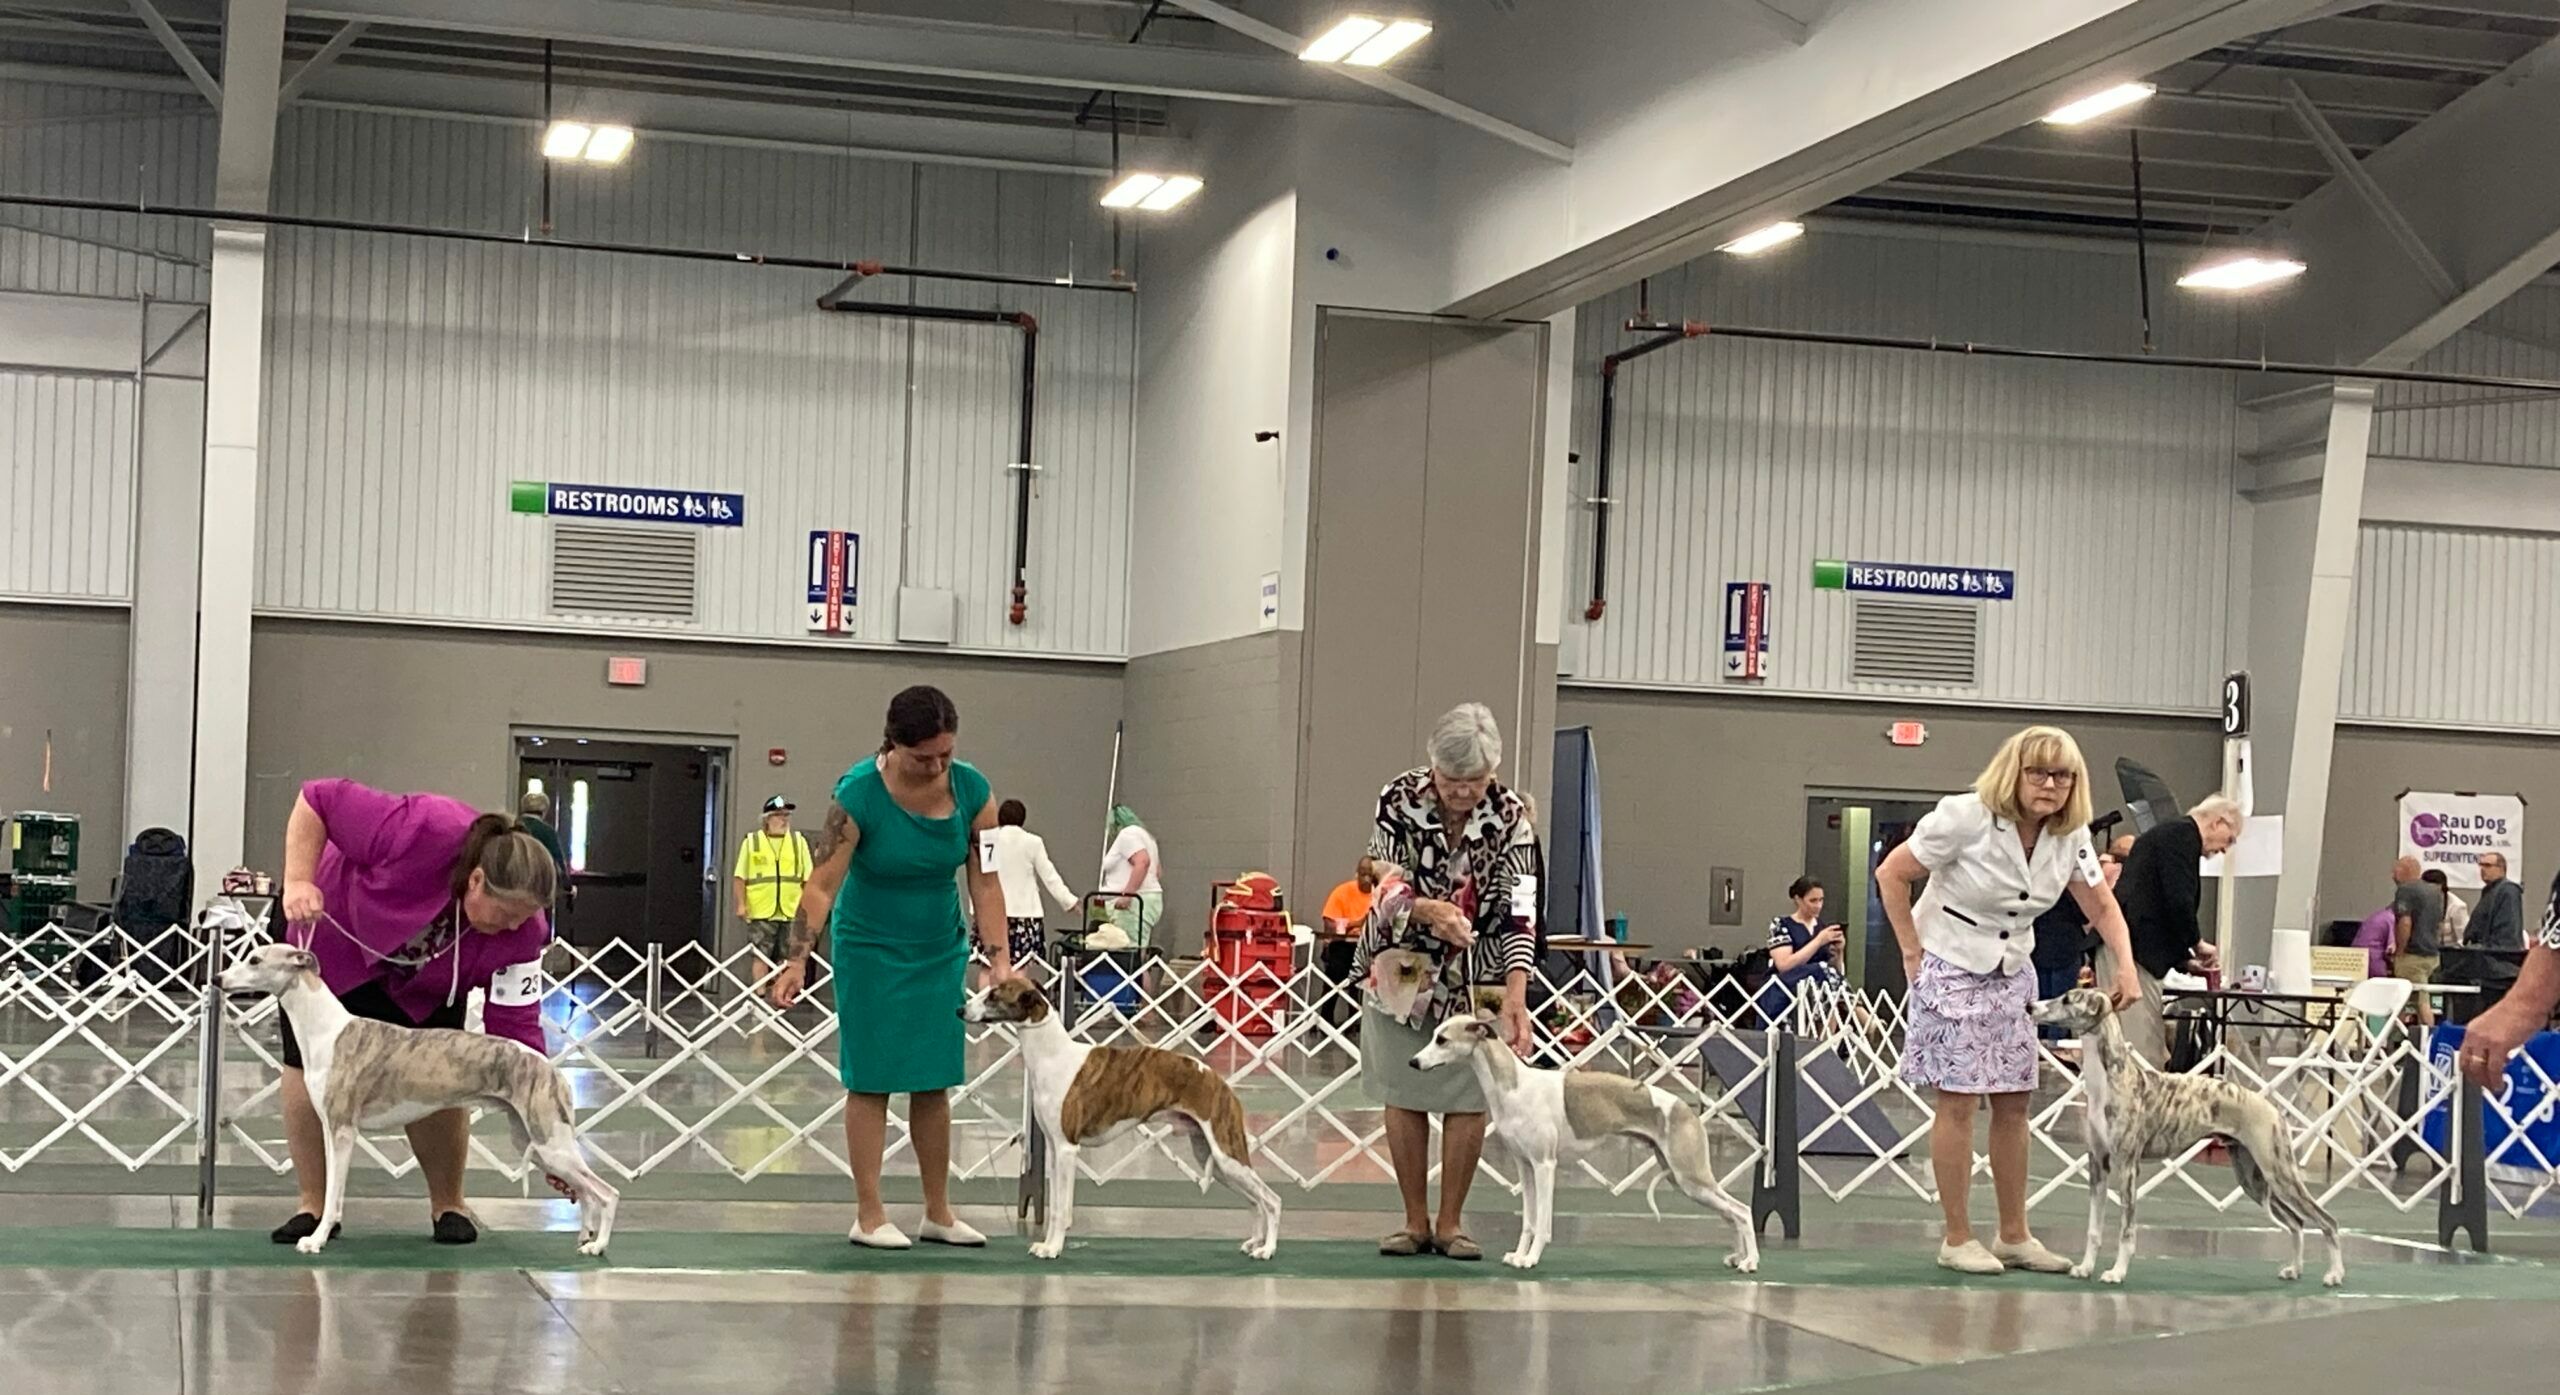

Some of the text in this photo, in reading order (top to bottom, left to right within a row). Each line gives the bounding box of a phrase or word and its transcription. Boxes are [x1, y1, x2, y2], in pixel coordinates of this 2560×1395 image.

[554, 489, 680, 517] RESTROOMS
[1851, 567, 1959, 592] RESTROOMS
[2225, 681, 2240, 733] 3
[2438, 813, 2507, 835] Rau Dog
[984, 843, 995, 862] 7
